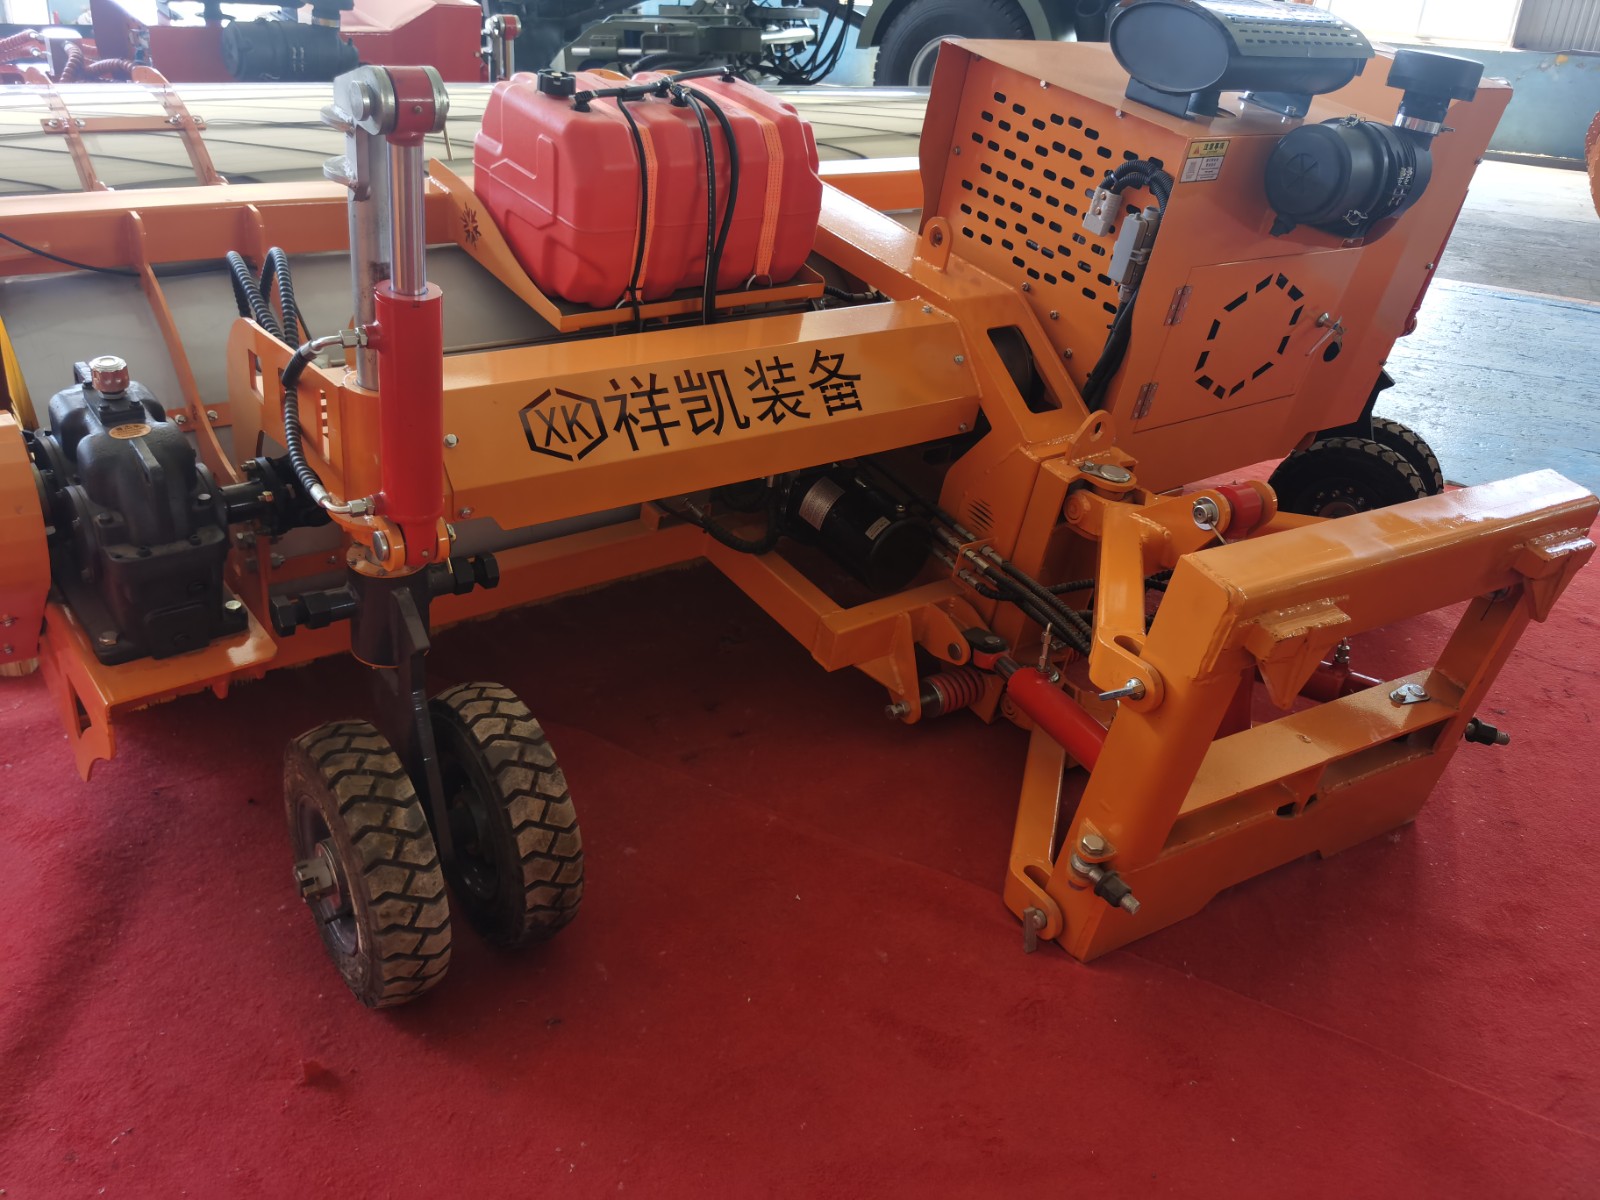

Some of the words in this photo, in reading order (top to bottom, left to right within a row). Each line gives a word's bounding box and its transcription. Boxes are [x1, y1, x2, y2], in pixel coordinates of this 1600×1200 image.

[534, 403, 594, 447] XK
[603, 349, 863, 451] 祥凯装备
